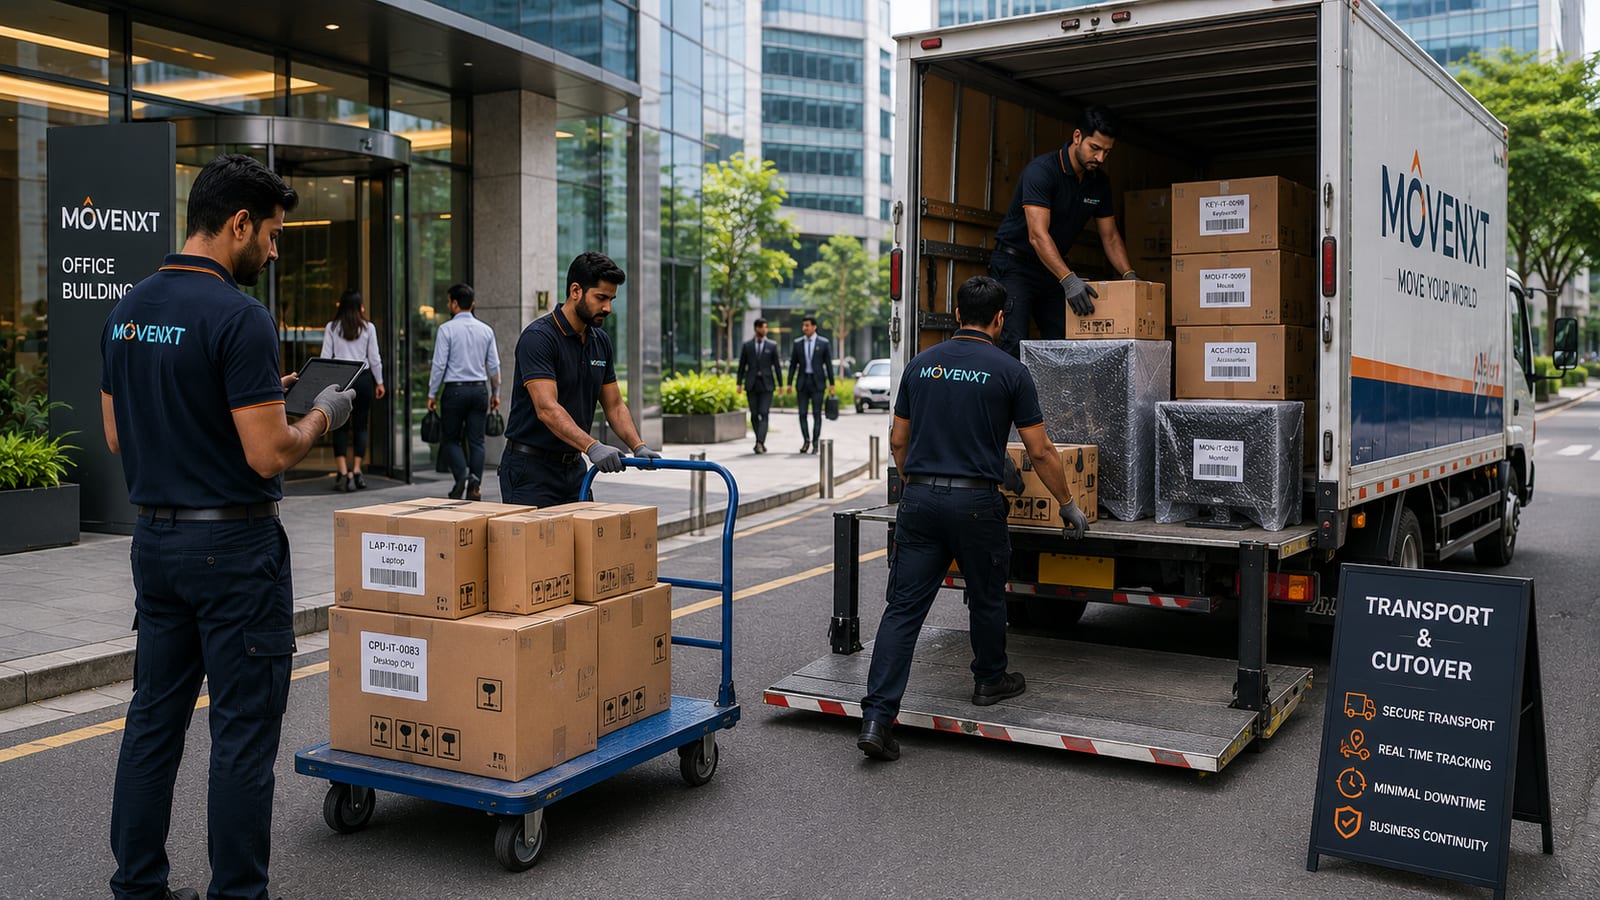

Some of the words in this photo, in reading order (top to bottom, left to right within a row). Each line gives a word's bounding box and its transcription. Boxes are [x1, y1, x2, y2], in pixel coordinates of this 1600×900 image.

[62, 256, 115, 275] OFFICE
[1397, 267, 1425, 298] MOVE
[1427, 276, 1450, 304] YOUR
[1451, 282, 1478, 309] WORLD
[381, 556, 405, 566] Laptop
[1365, 595, 1494, 627] TRANSPORT
[1416, 628, 1432, 648] &
[400, 659, 415, 670] CPU
[1371, 650, 1473, 681] CUTOVER
[1382, 705, 1426, 722] SECURE
[1427, 711, 1496, 732] TRANSPORT
[1378, 743, 1406, 758] REAL
[1407, 748, 1434, 762] TIME
[1435, 752, 1493, 771] TRACKING
[1374, 782, 1422, 800] MINIMAL
[1424, 790, 1487, 811] DOWNTIME
[1369, 820, 1421, 840] BUSINESS
[1422, 830, 1489, 852] CONTINUITY
